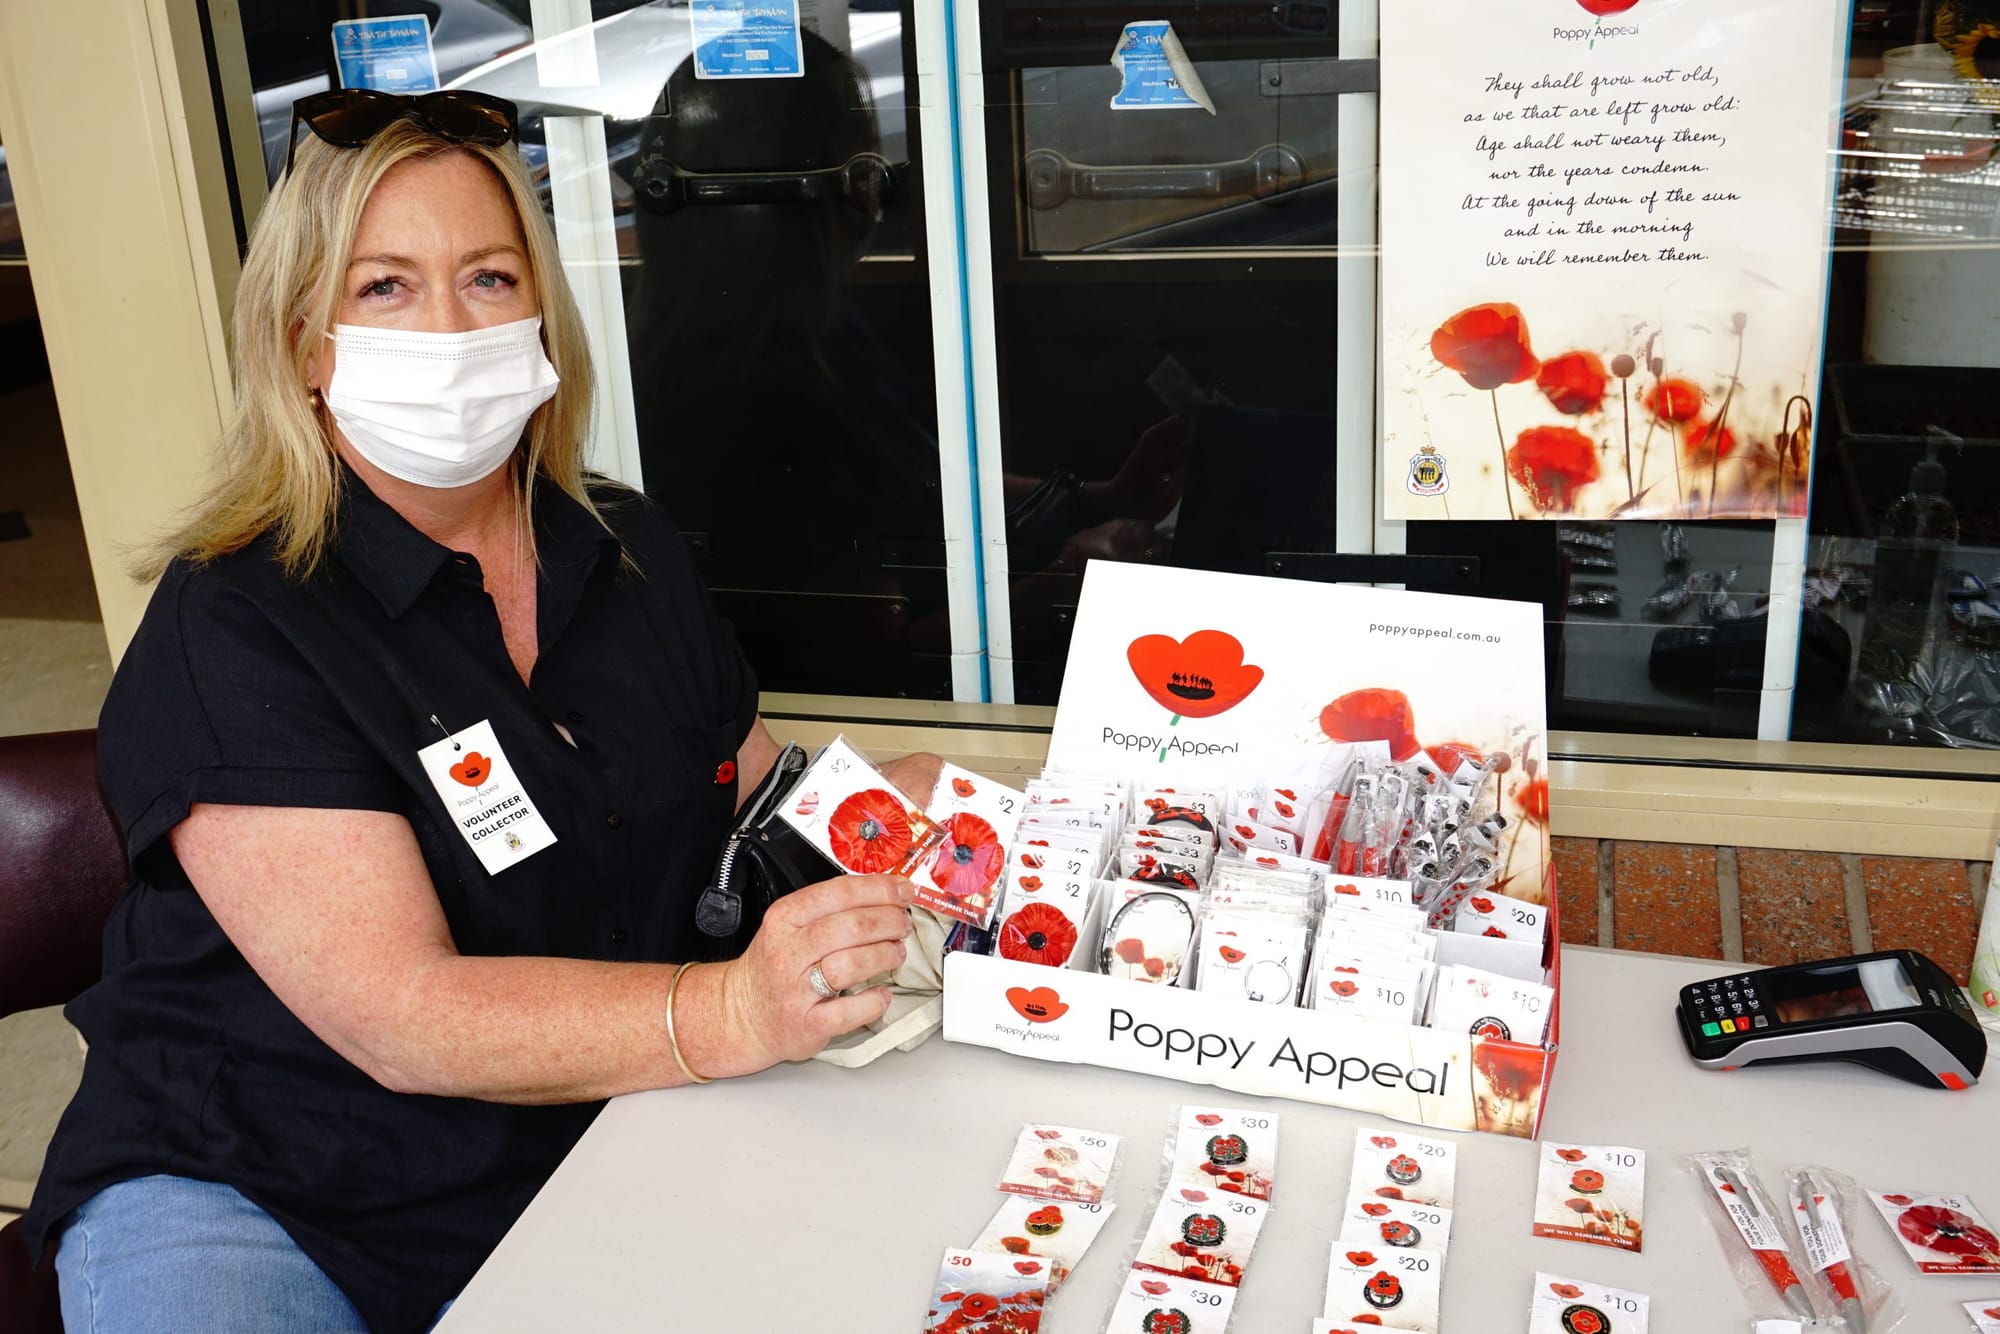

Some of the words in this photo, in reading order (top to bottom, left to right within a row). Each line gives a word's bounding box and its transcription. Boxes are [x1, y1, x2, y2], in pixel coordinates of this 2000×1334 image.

[1553, 27, 1591, 42] Poppy
[1594, 21, 1638, 40] Appeal
[1484, 72, 1524, 100] They
[1530, 71, 1583, 89] shall
[1590, 75, 1635, 97] grow
[1641, 68, 1680, 84] not
[1681, 64, 1718, 87] old,
[1463, 113, 1485, 123] as
[1492, 110, 1514, 122] we
[1521, 105, 1569, 119] that
[1569, 107, 1599, 118] are
[1605, 99, 1644, 126] left
[1650, 103, 1696, 125] grow
[1702, 94, 1740, 112] old:
[1475, 134, 1506, 161] Age
[1512, 131, 1564, 150] shall
[1570, 132, 1610, 148] not
[1610, 135, 1665, 153] weary
[1671, 127, 1725, 148] them,
[1488, 170, 1520, 180] nor
[1527, 162, 1556, 178] the
[1563, 166, 1614, 187] years
[1621, 159, 1708, 175] condemn.
[1461, 193, 1490, 211] At
[1491, 193, 1520, 209] the
[1527, 191, 1577, 218] going
[1583, 191, 1632, 206] down
[1639, 189, 1658, 215] of
[1664, 187, 1694, 203] the
[1701, 192, 1741, 202] sun
[1503, 222, 1540, 238] and
[1546, 220, 1568, 236] in
[1575, 219, 1605, 235] the
[1610, 217, 1694, 243] morning
[1486, 251, 1509, 267] We
[1516, 248, 1556, 266] will
[1562, 248, 1650, 264] remember
[1657, 246, 1708, 262] them.
[1369, 622, 1502, 645] poppyappeal.com.au
[1102, 727, 1163, 753] Poppy
[1167, 735, 1239, 756] Appeal
[457, 794, 478, 808] Poppy
[478, 784, 500, 798] Appeal
[998, 795, 1015, 815] $2
[463, 794, 522, 829] VOLUNTEER
[1191, 802, 1206, 815] $3
[472, 807, 530, 842] COLLECTOR
[1187, 834, 1202, 845] $3
[1183, 847, 1199, 858] $3
[1066, 860, 1082, 875] $2
[1065, 882, 1080, 898] $2
[1376, 889, 1402, 903] $10
[1511, 907, 1536, 926] $20
[1377, 987, 1405, 1006] $10
[1512, 991, 1541, 1013] $10
[996, 1023, 1025, 1036] Poppy
[1026, 1029, 1060, 1041] Appeal
[1109, 1007, 1256, 1071] Poppy
[1268, 1036, 1450, 1097] Appeal
[1240, 1117, 1269, 1129] $30
[1079, 1136, 1107, 1148] $50
[1417, 1142, 1446, 1158] $20
[1605, 1152, 1636, 1167] $10
[1227, 1199, 1257, 1216] $30
[1411, 1210, 1441, 1224] $20
[1398, 1256, 1430, 1272] $20
[1190, 1289, 1222, 1307] $30
[1604, 1294, 1638, 1312] $10
